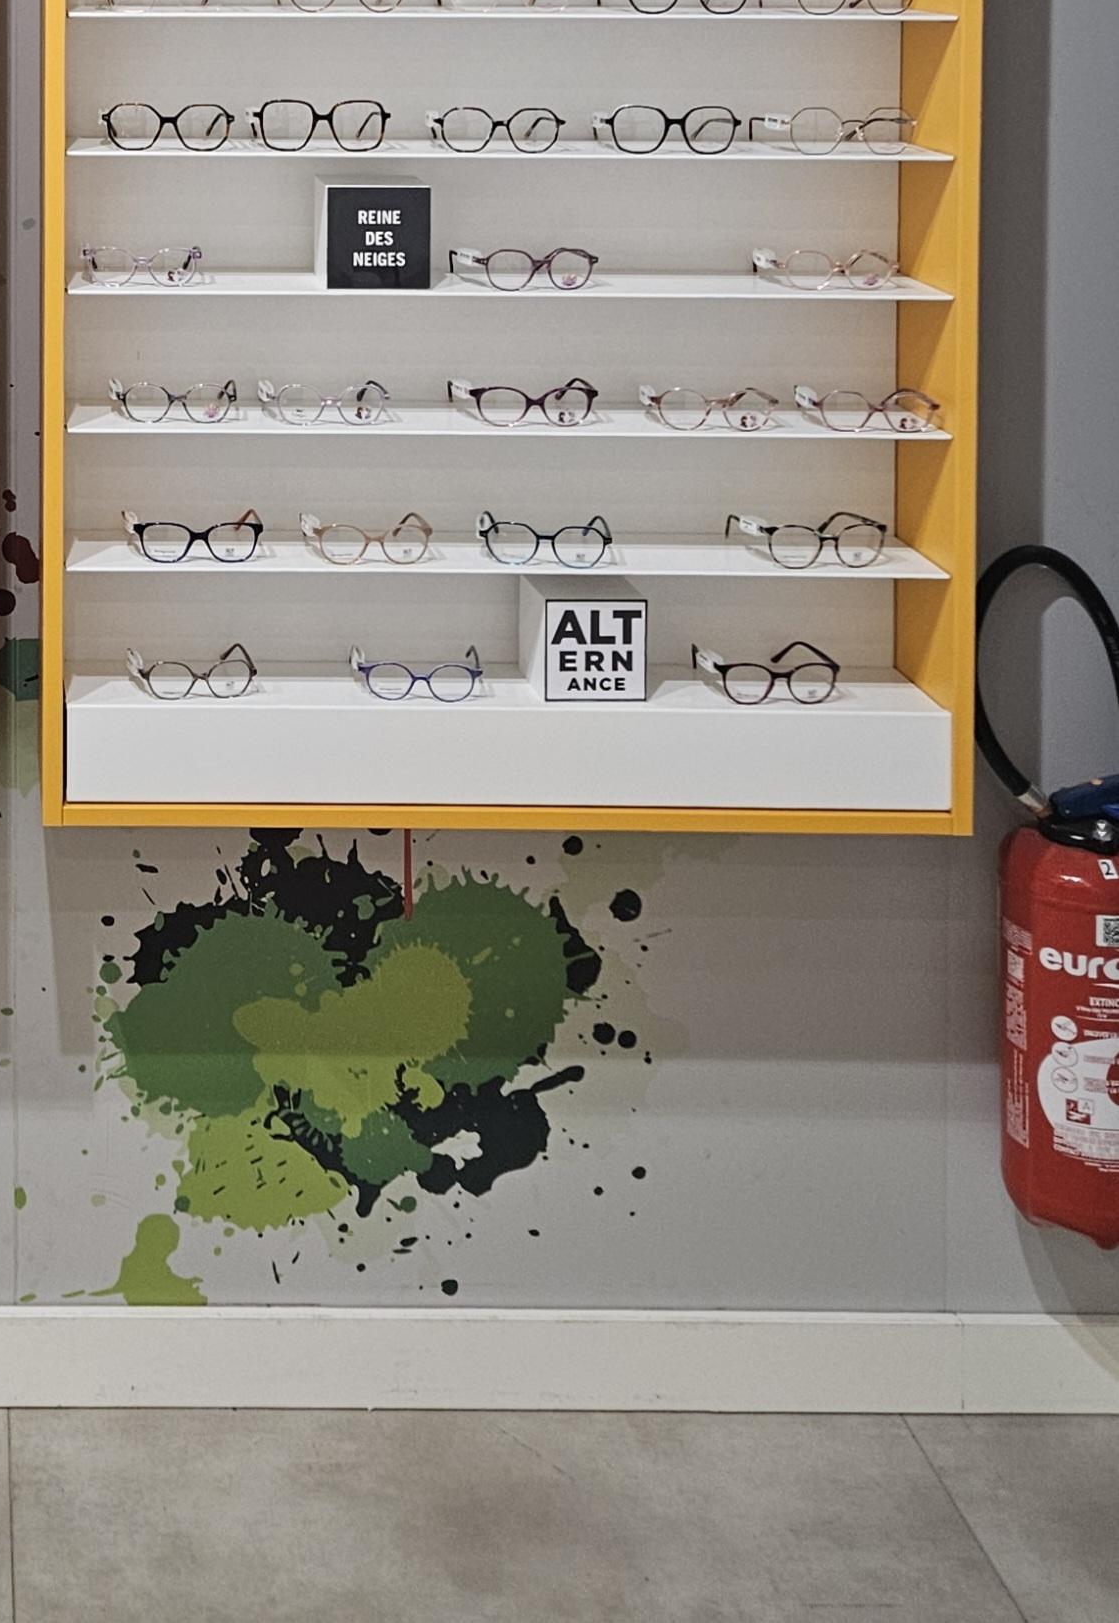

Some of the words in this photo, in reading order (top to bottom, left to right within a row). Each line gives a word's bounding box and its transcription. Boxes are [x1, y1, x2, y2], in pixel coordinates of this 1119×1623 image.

[357, 210, 401, 225] REINE
[365, 231, 394, 246] DES
[353, 252, 406, 267] NEIGES
[550, 609, 642, 645] ALT
[559, 650, 633, 672] ERN
[567, 677, 626, 691] ANCE
